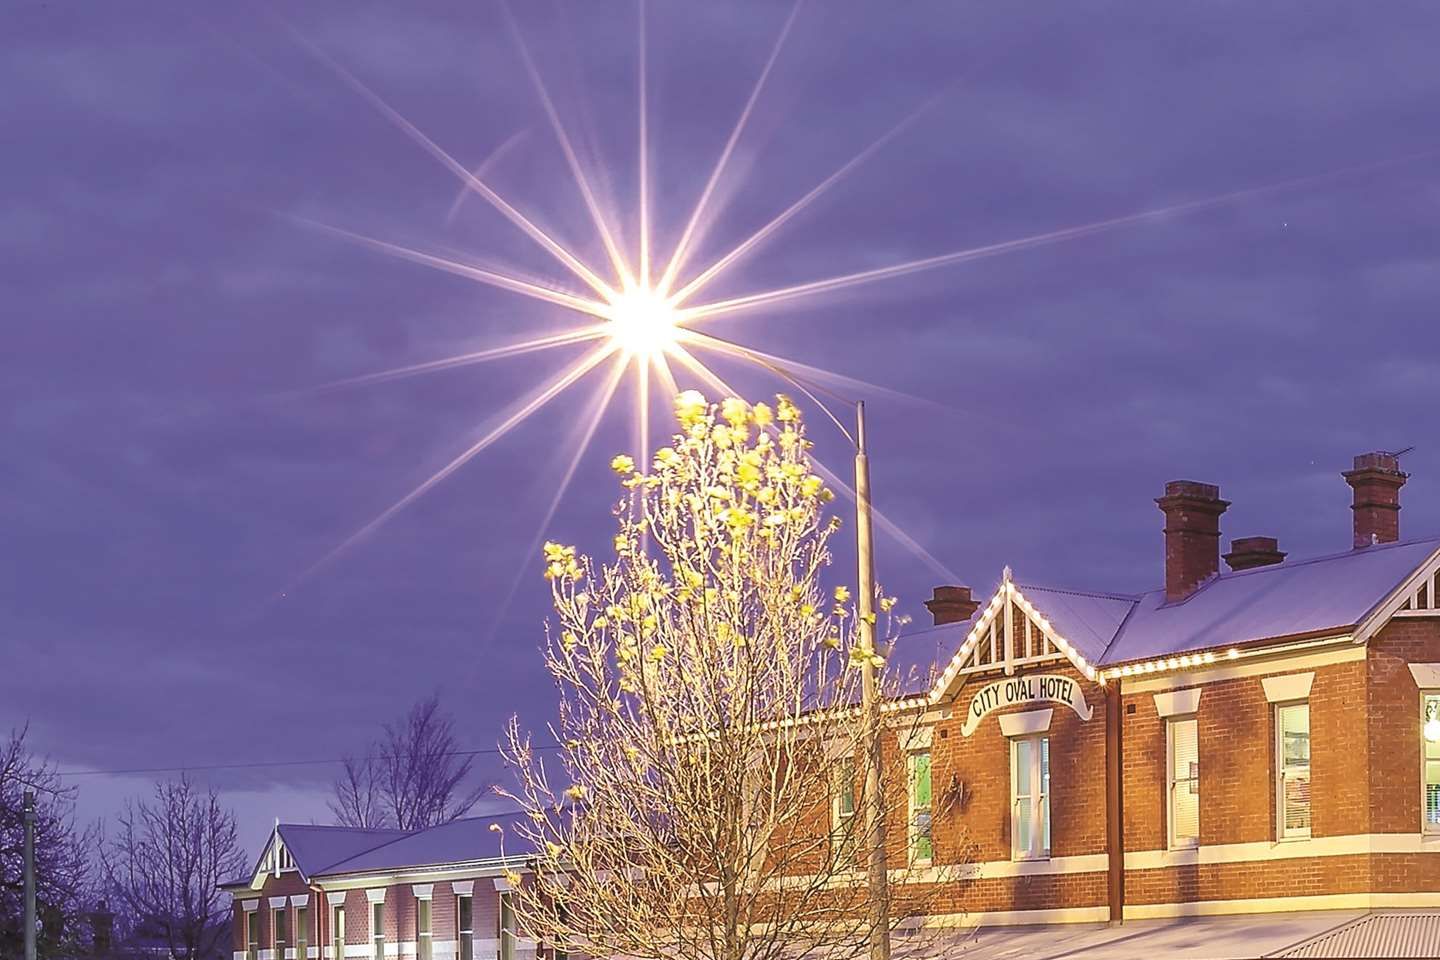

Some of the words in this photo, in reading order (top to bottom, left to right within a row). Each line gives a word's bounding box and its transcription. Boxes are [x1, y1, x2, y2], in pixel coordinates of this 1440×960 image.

[973, 684, 1000, 717] CITY
[1005, 679, 1035, 702] OVAL
[1040, 678, 1073, 705] HOTEL
